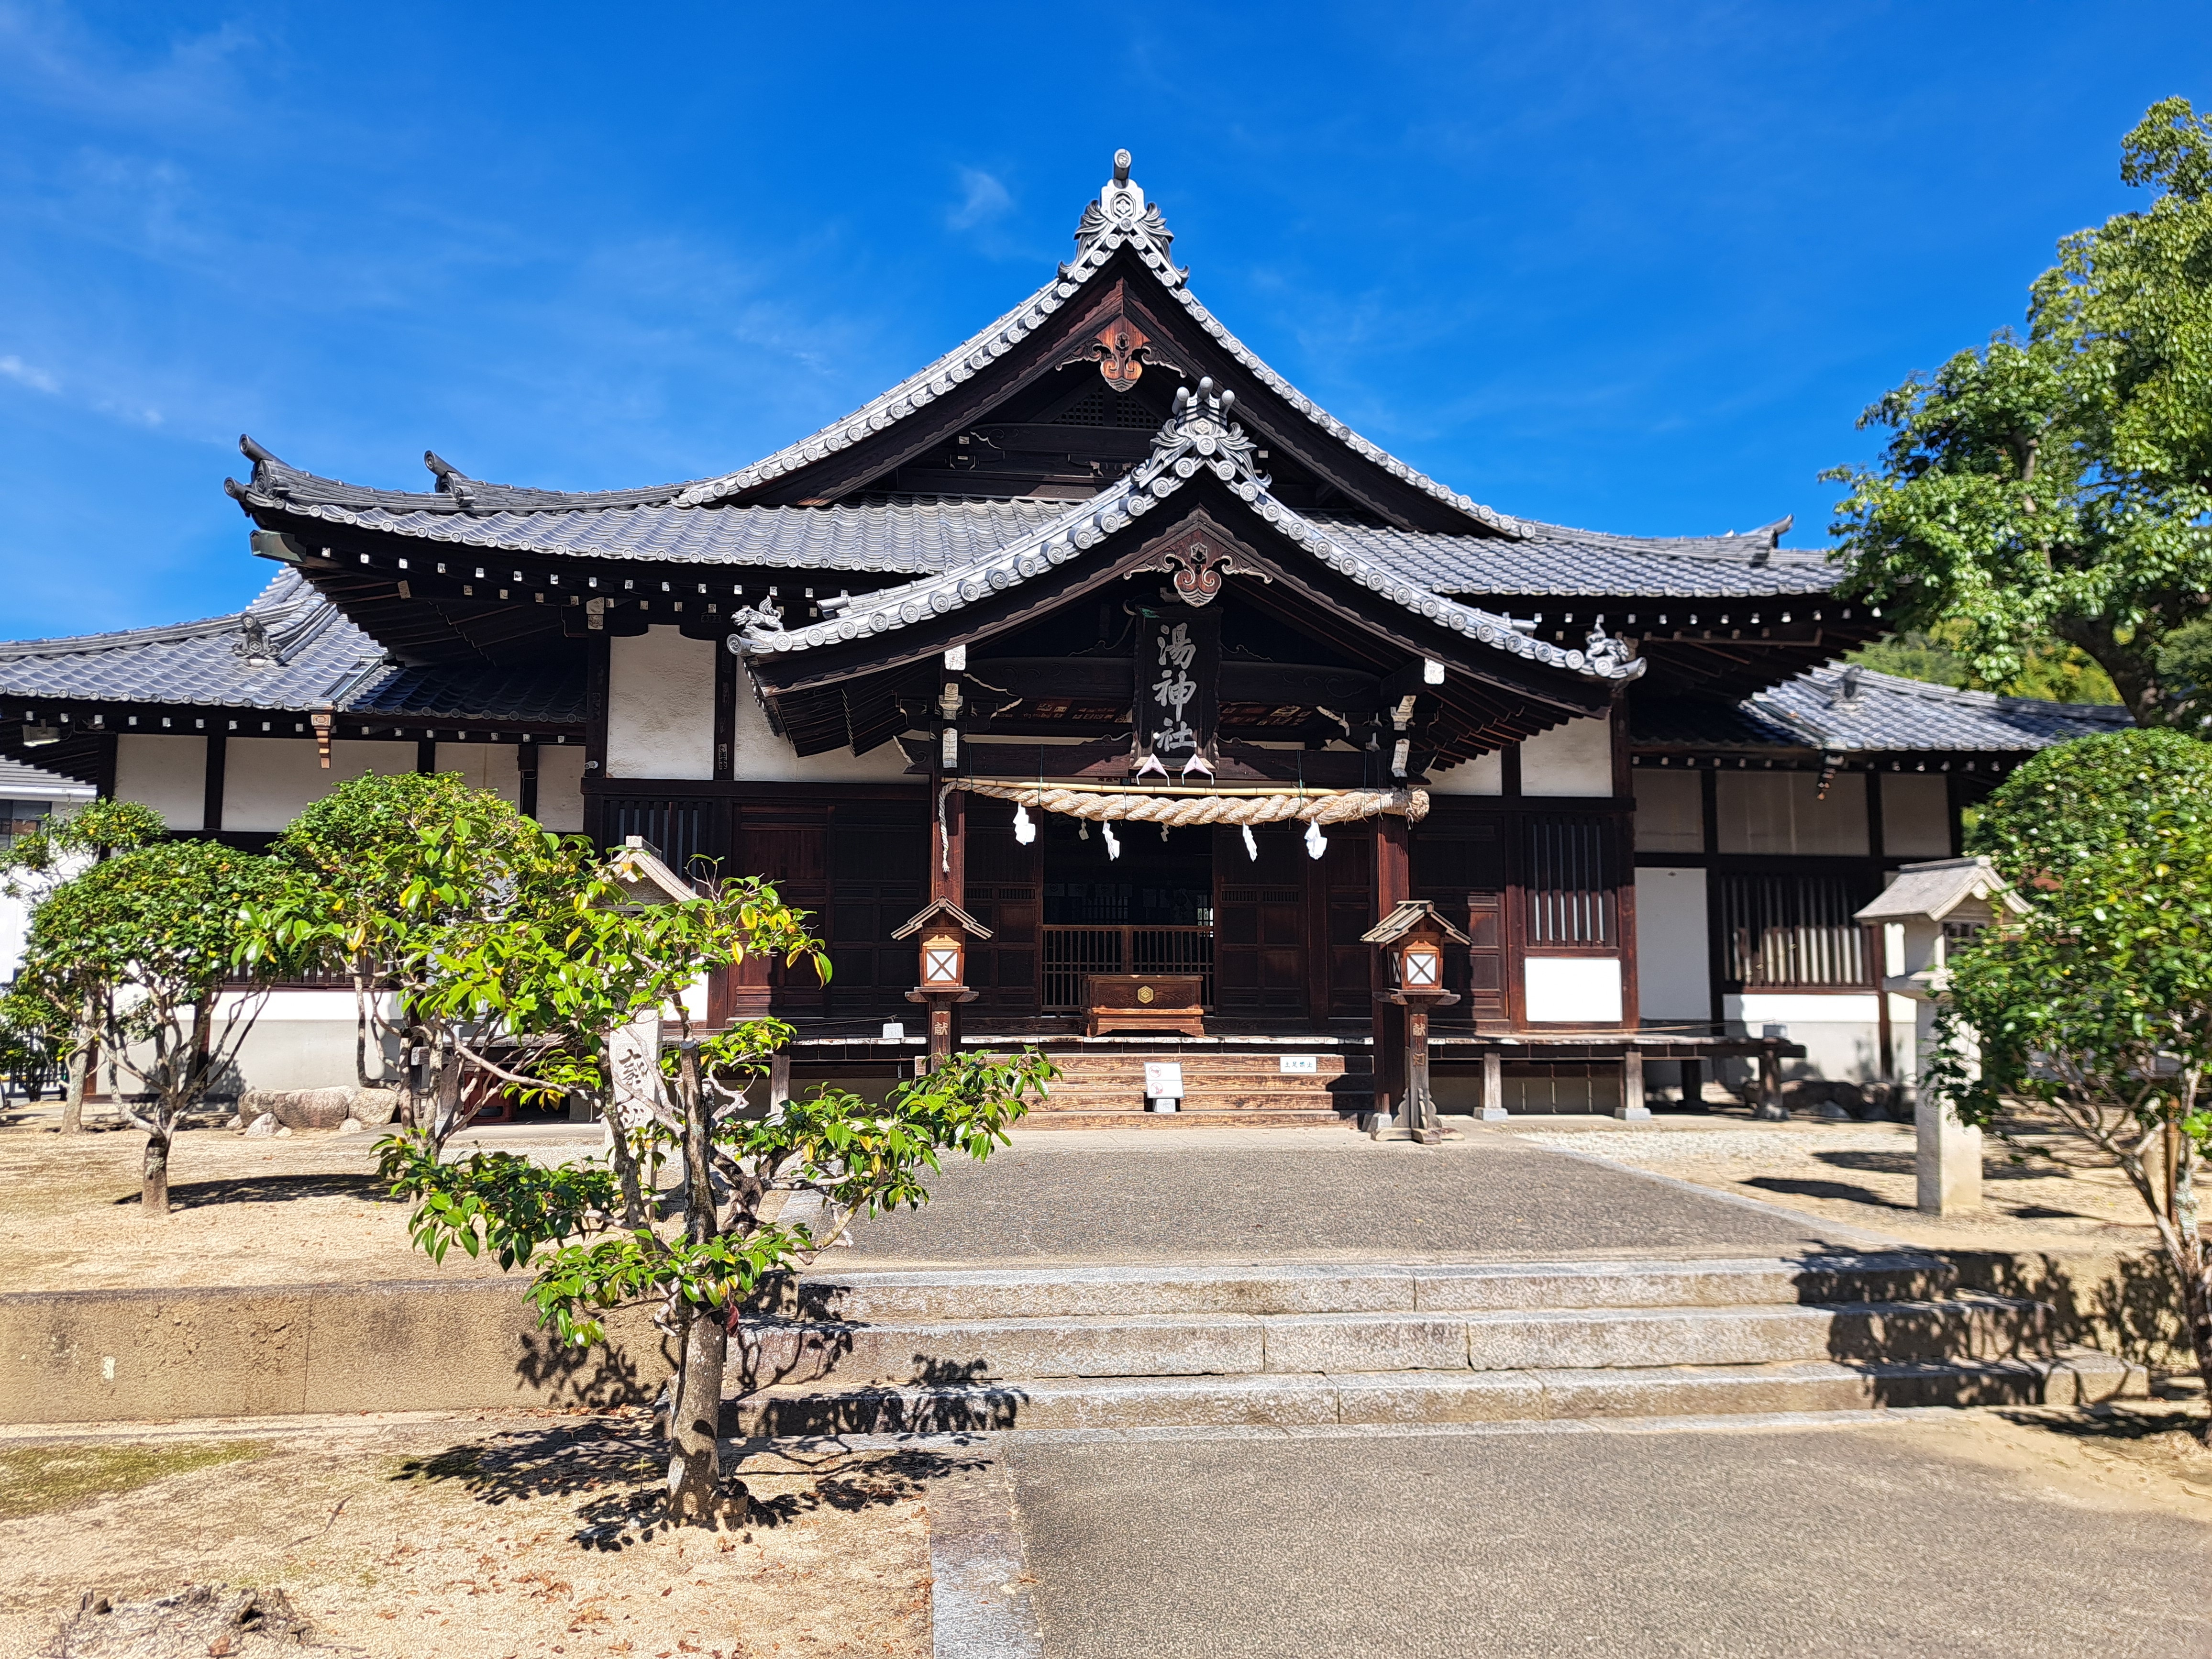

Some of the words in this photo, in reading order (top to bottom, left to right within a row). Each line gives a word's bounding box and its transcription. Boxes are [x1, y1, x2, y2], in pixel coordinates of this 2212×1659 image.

[1152, 622, 1196, 752] 湯神社
[1412, 1022, 1426, 1067] 献灯
